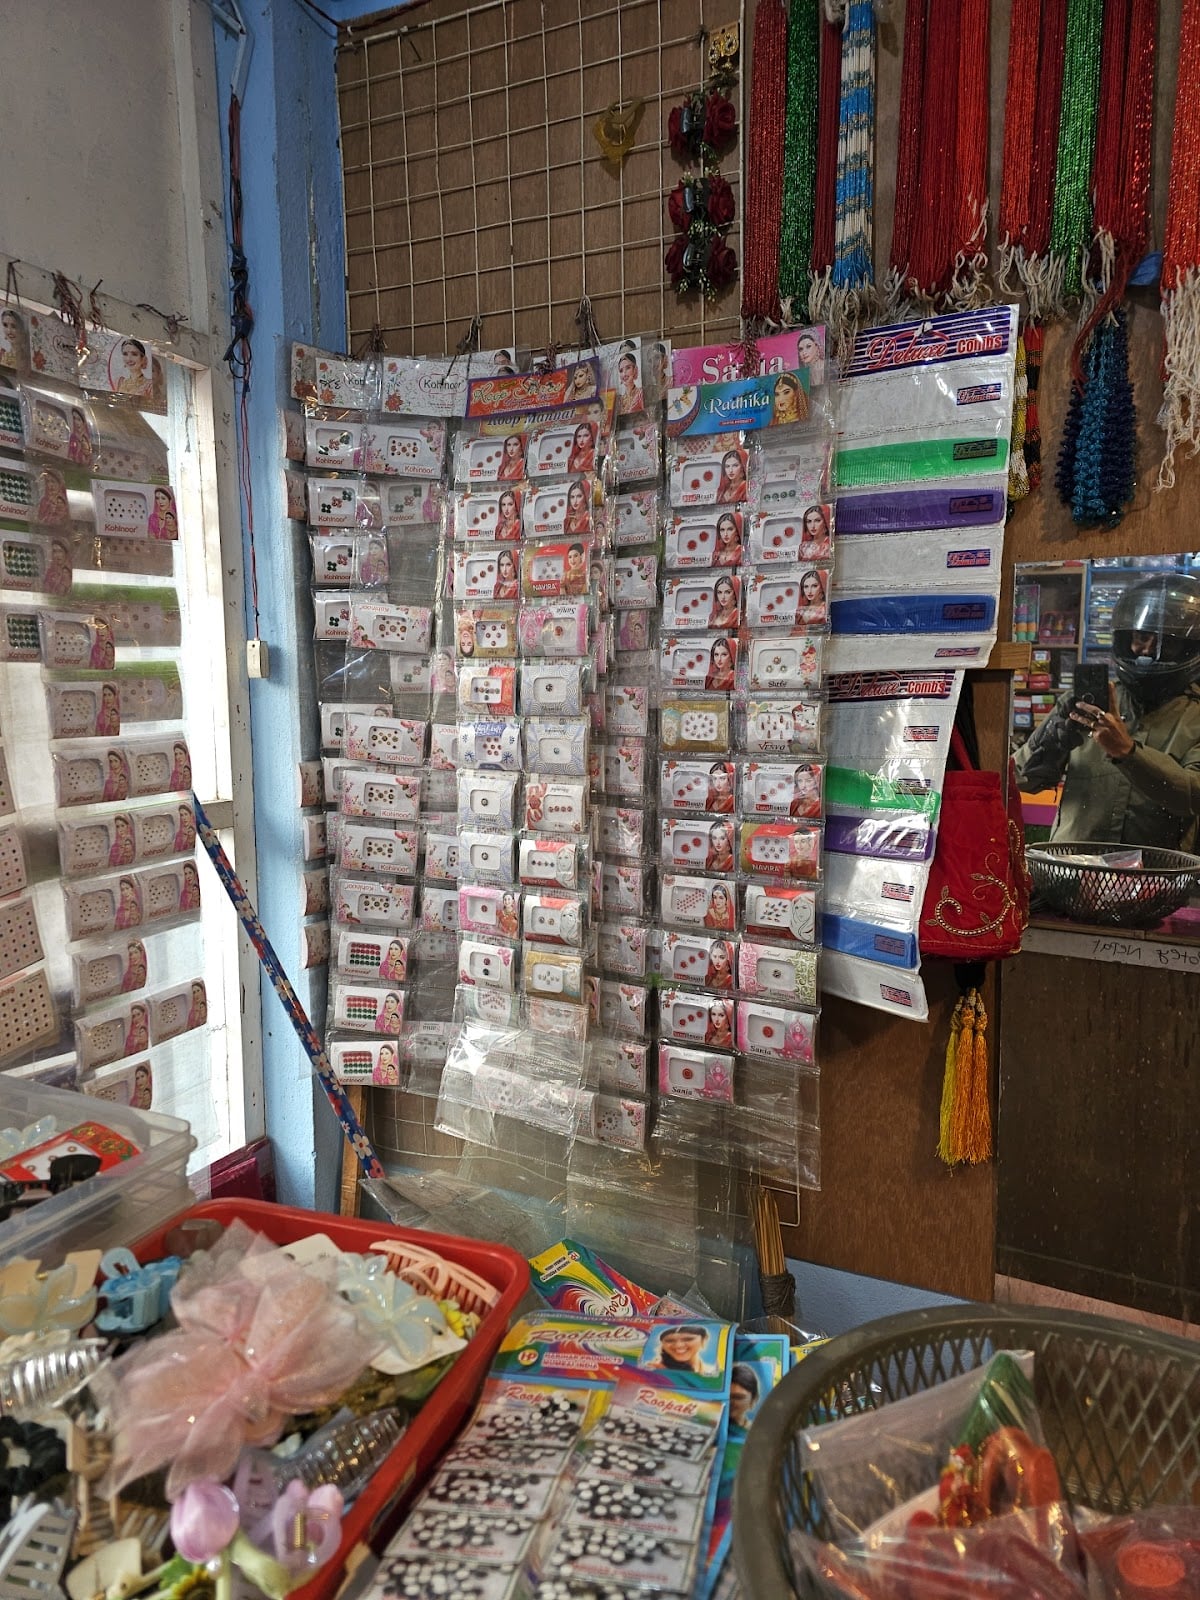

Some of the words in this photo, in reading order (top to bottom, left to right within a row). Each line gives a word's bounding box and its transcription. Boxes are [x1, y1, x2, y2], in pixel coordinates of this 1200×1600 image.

[866, 331, 950, 370] Deluxe
[957, 335, 1002, 354] Combs
[702, 355, 785, 385] Saia
[704, 393, 770, 418] Radhika
[315, 456, 344, 466] Kohinoor
[404, 466, 436, 474] Kohinoor
[318, 515, 348, 523] Kohinoor
[104, 524, 138, 534] Kohinoor
[533, 584, 556, 592] NAVIRA
[906, 681, 947, 695] Combs
[753, 864, 780, 872] NAVIRA
[751, 1045, 772, 1056] Sania
[672, 1086, 693, 1096] Sania
[529, 1326, 634, 1346] Roopali
[580, 1354, 624, 1364] PRODUCTS
[576, 1362, 598, 1370] INDIA
[636, 1388, 696, 1416] Roopali
